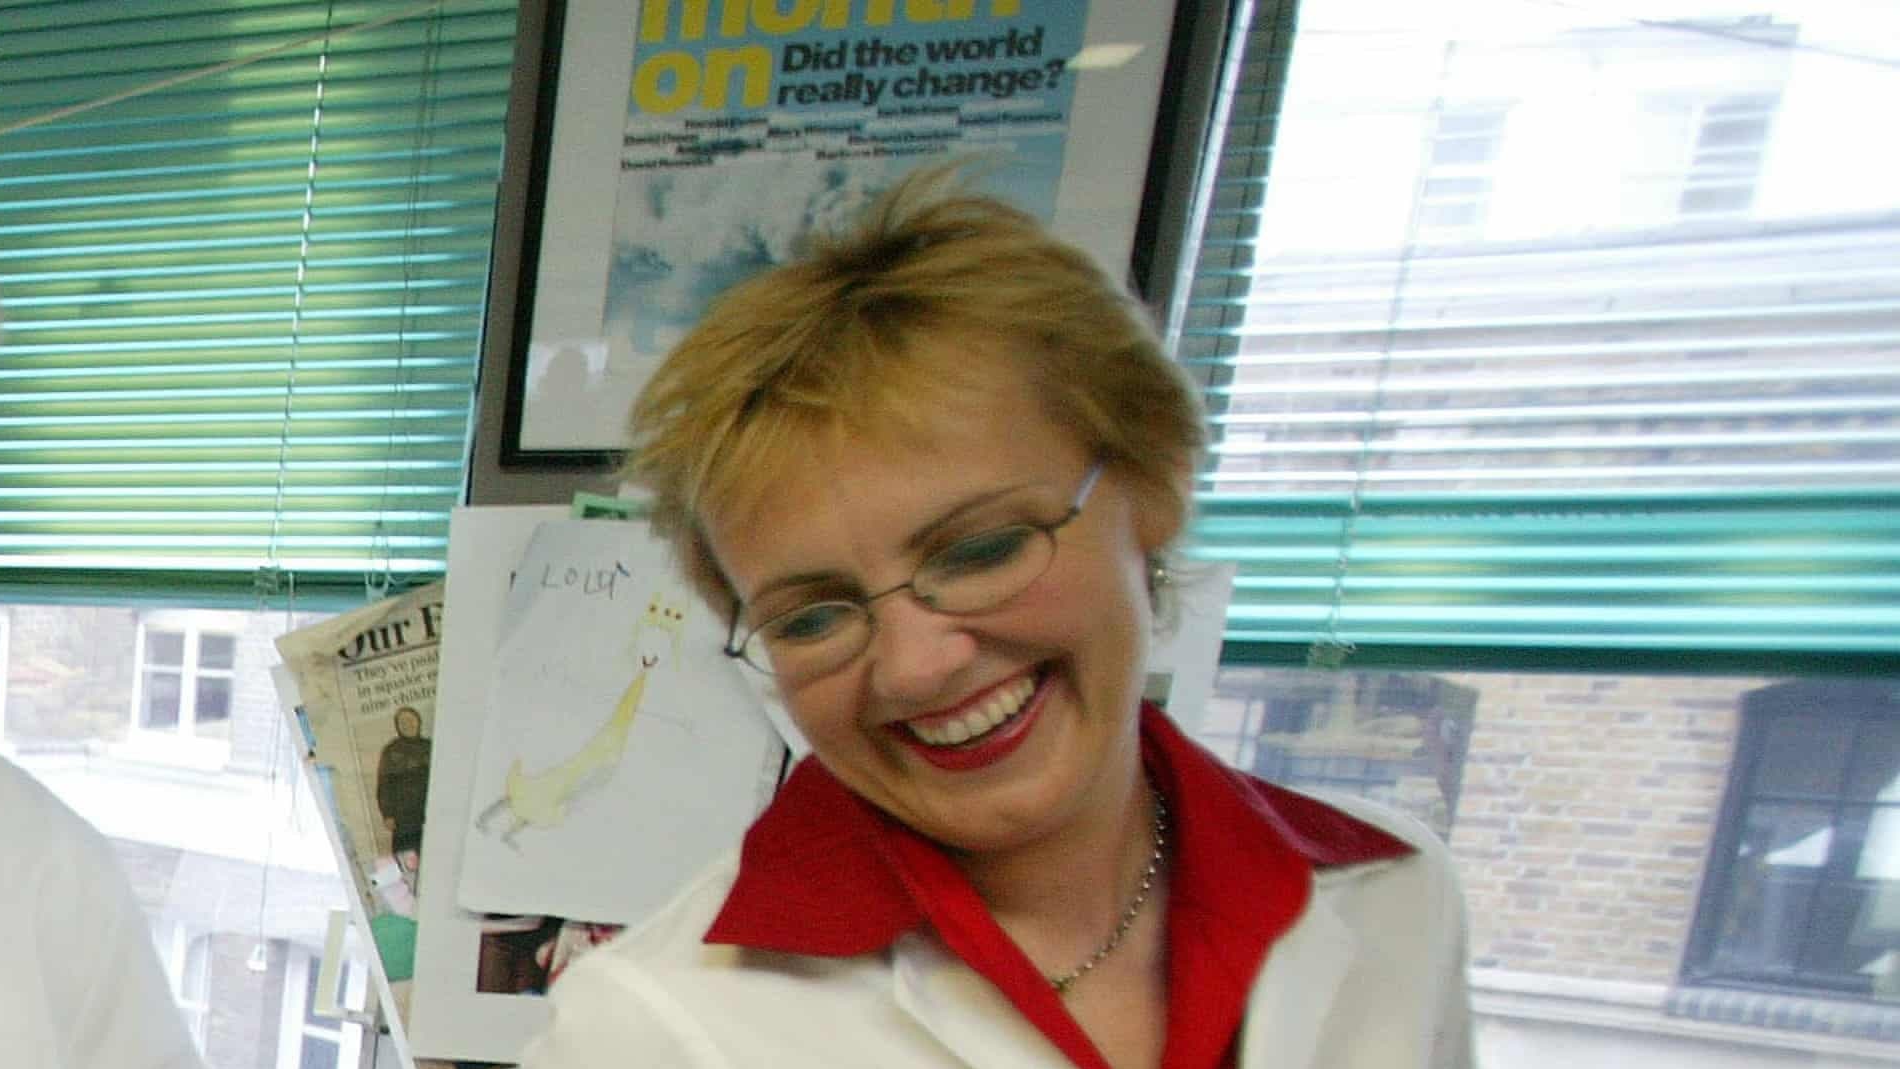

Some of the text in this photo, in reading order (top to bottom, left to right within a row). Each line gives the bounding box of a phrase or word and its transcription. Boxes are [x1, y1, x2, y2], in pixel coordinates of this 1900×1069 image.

[640, 0, 1022, 43] mon
[781, 26, 1045, 73] Did the world
[632, 44, 772, 115] on
[777, 58, 1067, 107] really change?
